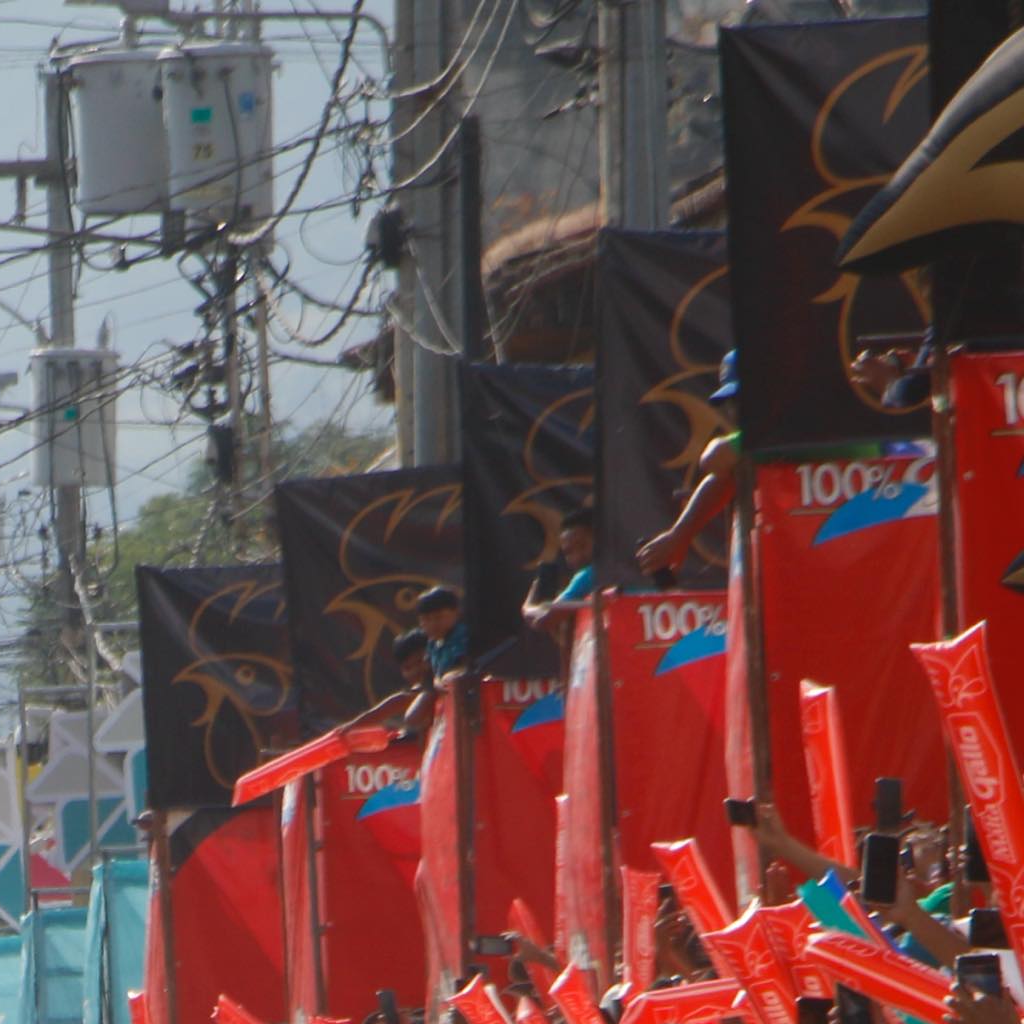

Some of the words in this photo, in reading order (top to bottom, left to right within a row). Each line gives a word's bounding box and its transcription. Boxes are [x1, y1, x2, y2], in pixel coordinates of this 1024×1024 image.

[796, 461, 902, 506] 100%
[637, 601, 727, 642] 100%
[344, 764, 414, 794] 100%
